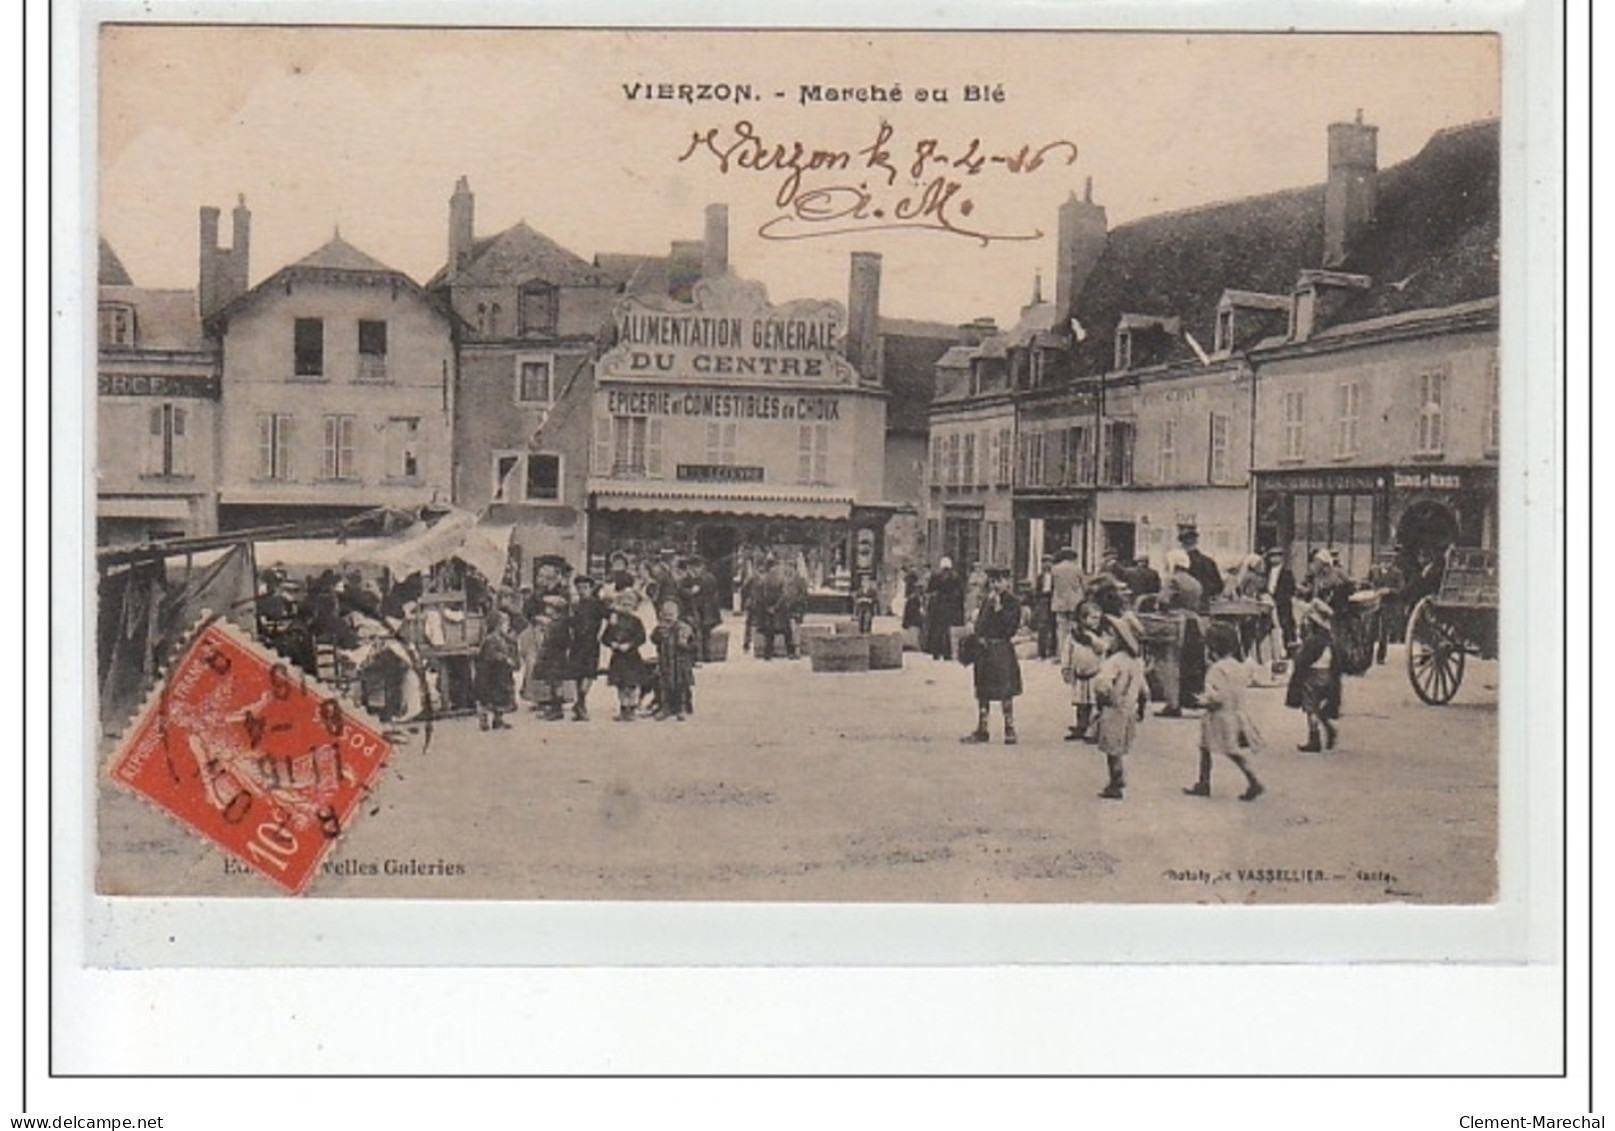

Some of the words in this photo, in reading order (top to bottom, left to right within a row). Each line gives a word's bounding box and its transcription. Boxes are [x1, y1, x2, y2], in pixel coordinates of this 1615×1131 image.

[622, 82, 761, 104] VIERZON.
[799, 82, 903, 107] Marché
[914, 87, 949, 102] au
[963, 82, 1007, 103] Blé
[620, 314, 742, 350] ALIMENTATION
[630, 352, 675, 371] DU
[692, 355, 823, 377] CENTRE
[684, 394, 780, 419] COMESTIBLES
[797, 397, 840, 420] CHOIX
[246, 822, 300, 872] 10
[383, 858, 466, 877] Galeries
